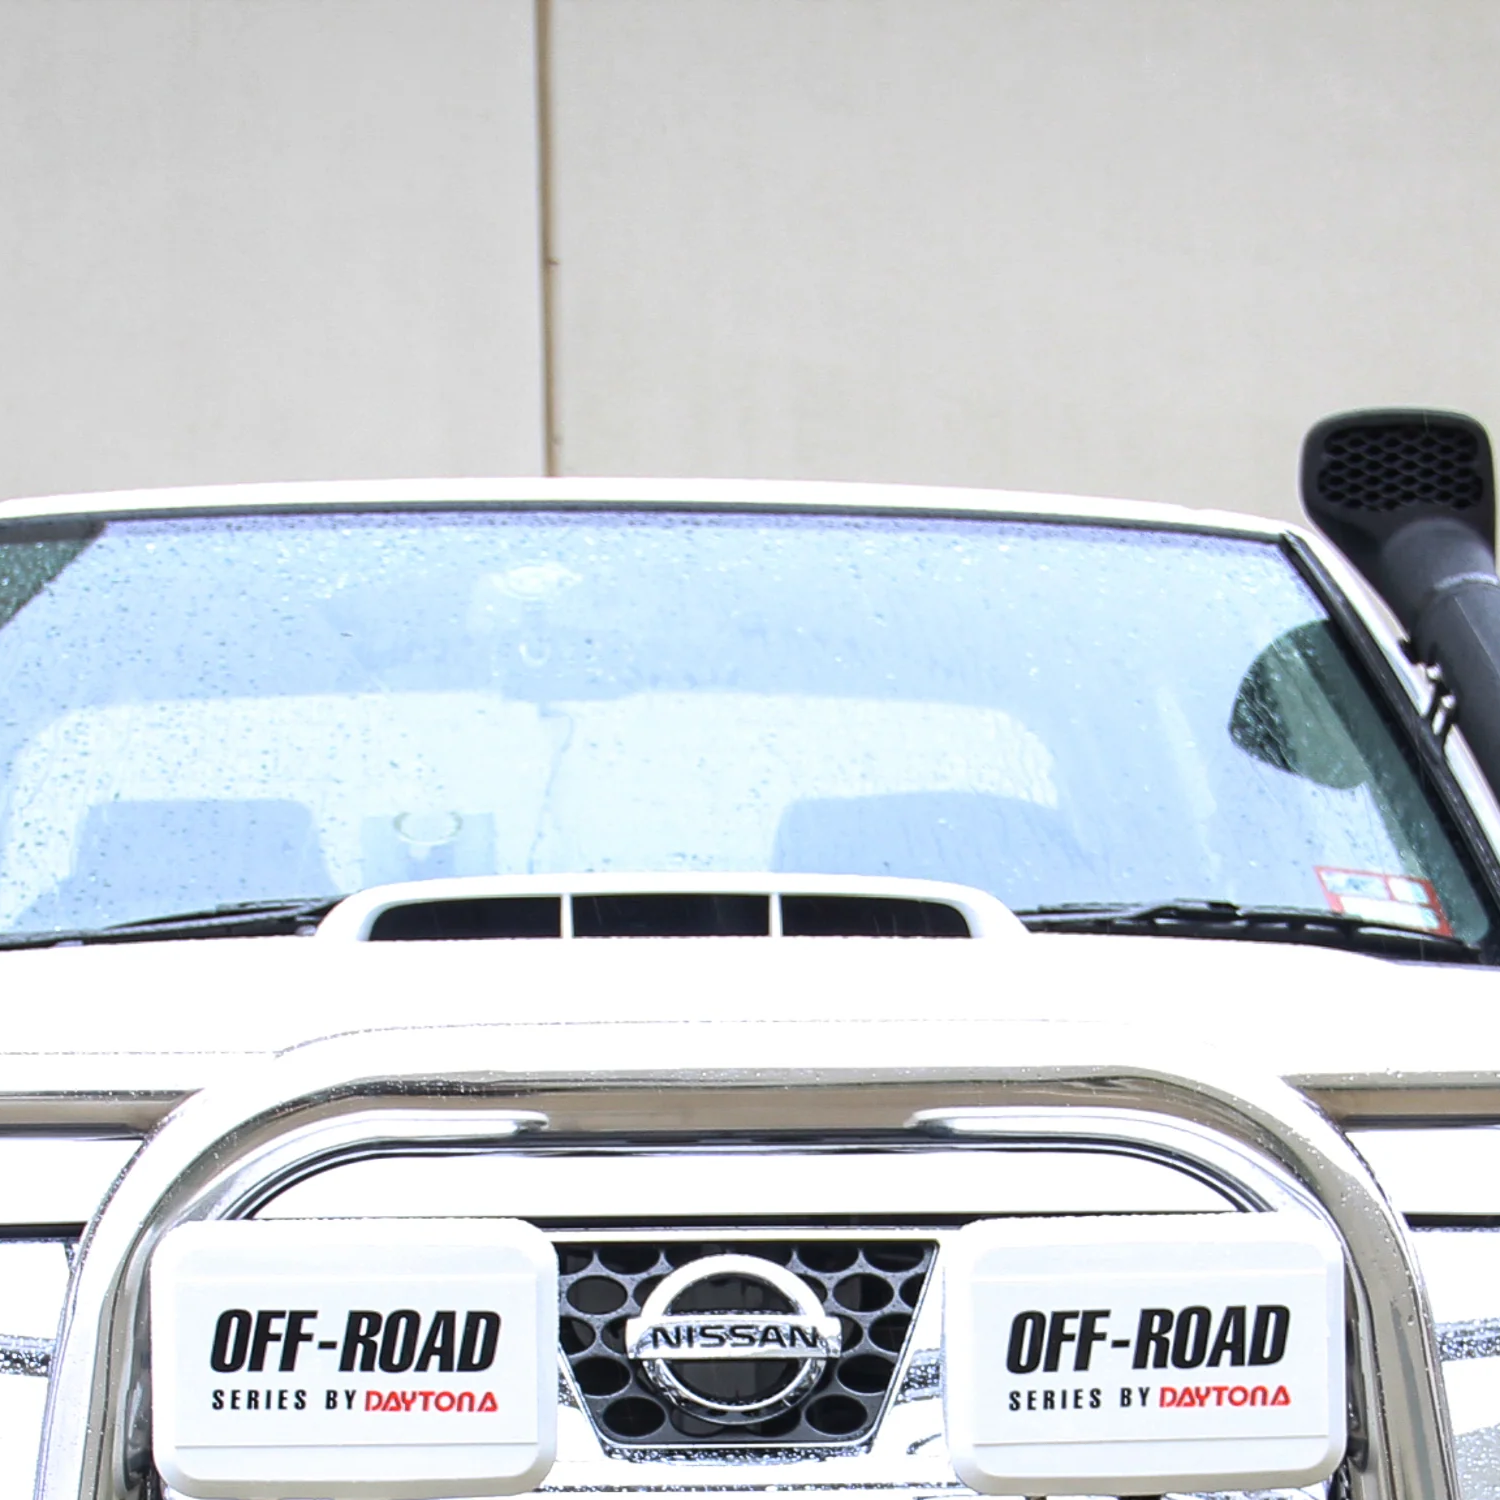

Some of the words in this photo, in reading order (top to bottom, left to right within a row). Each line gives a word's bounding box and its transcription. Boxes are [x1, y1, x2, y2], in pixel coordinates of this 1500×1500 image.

[210, 1308, 501, 1373] OFF-ROAD
[651, 1323, 819, 1349] NISSAN
[1006, 1304, 1290, 1374] OFF-ROAD
[211, 1389, 308, 1411] SERIES
[325, 1389, 358, 1411] BY
[364, 1389, 499, 1412] DAYTONA
[1008, 1387, 1102, 1412] SERIES
[1120, 1386, 1150, 1408] BY
[1159, 1384, 1292, 1408] DAYTONA
